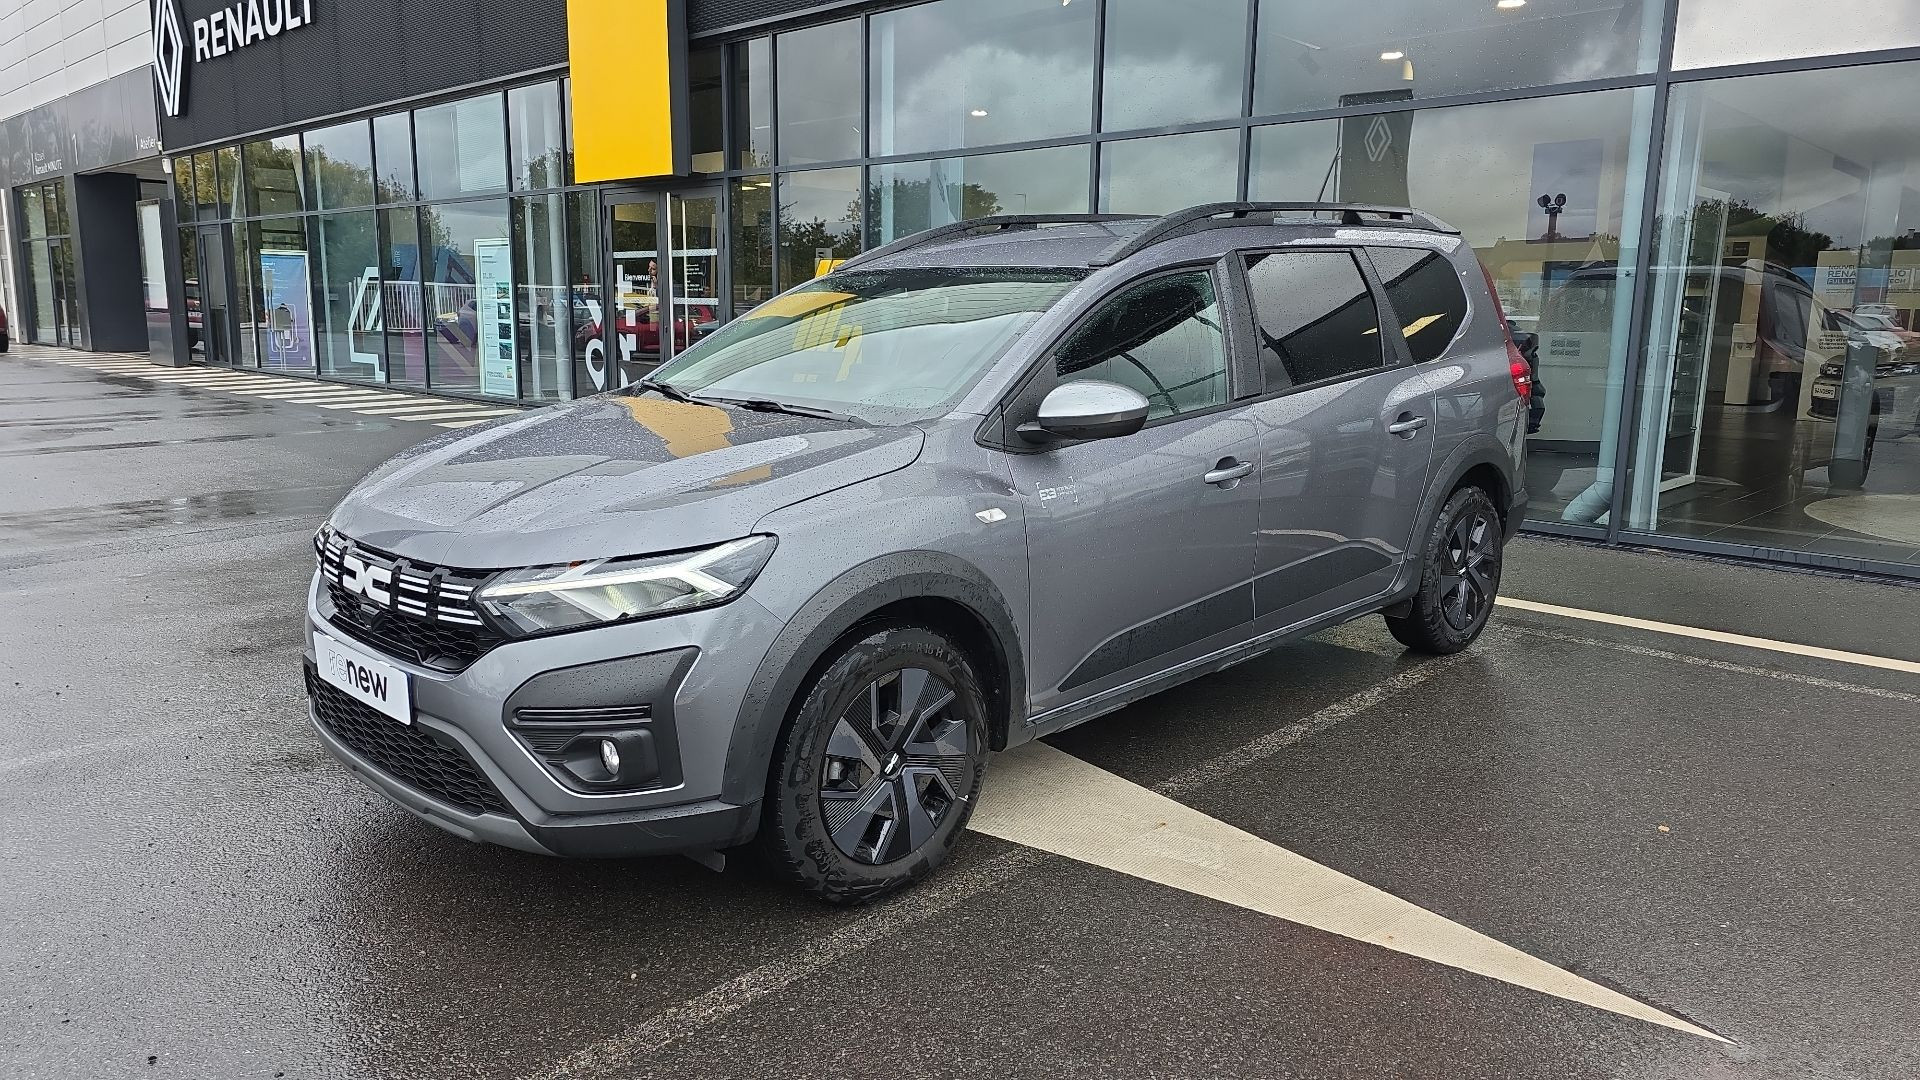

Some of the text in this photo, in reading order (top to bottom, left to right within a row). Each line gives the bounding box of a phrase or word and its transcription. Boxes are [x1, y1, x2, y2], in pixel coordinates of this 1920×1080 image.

[624, 273, 651, 281] Bienvenue
[1827, 270, 1857, 278] RENA
[328, 648, 388, 702] renew
